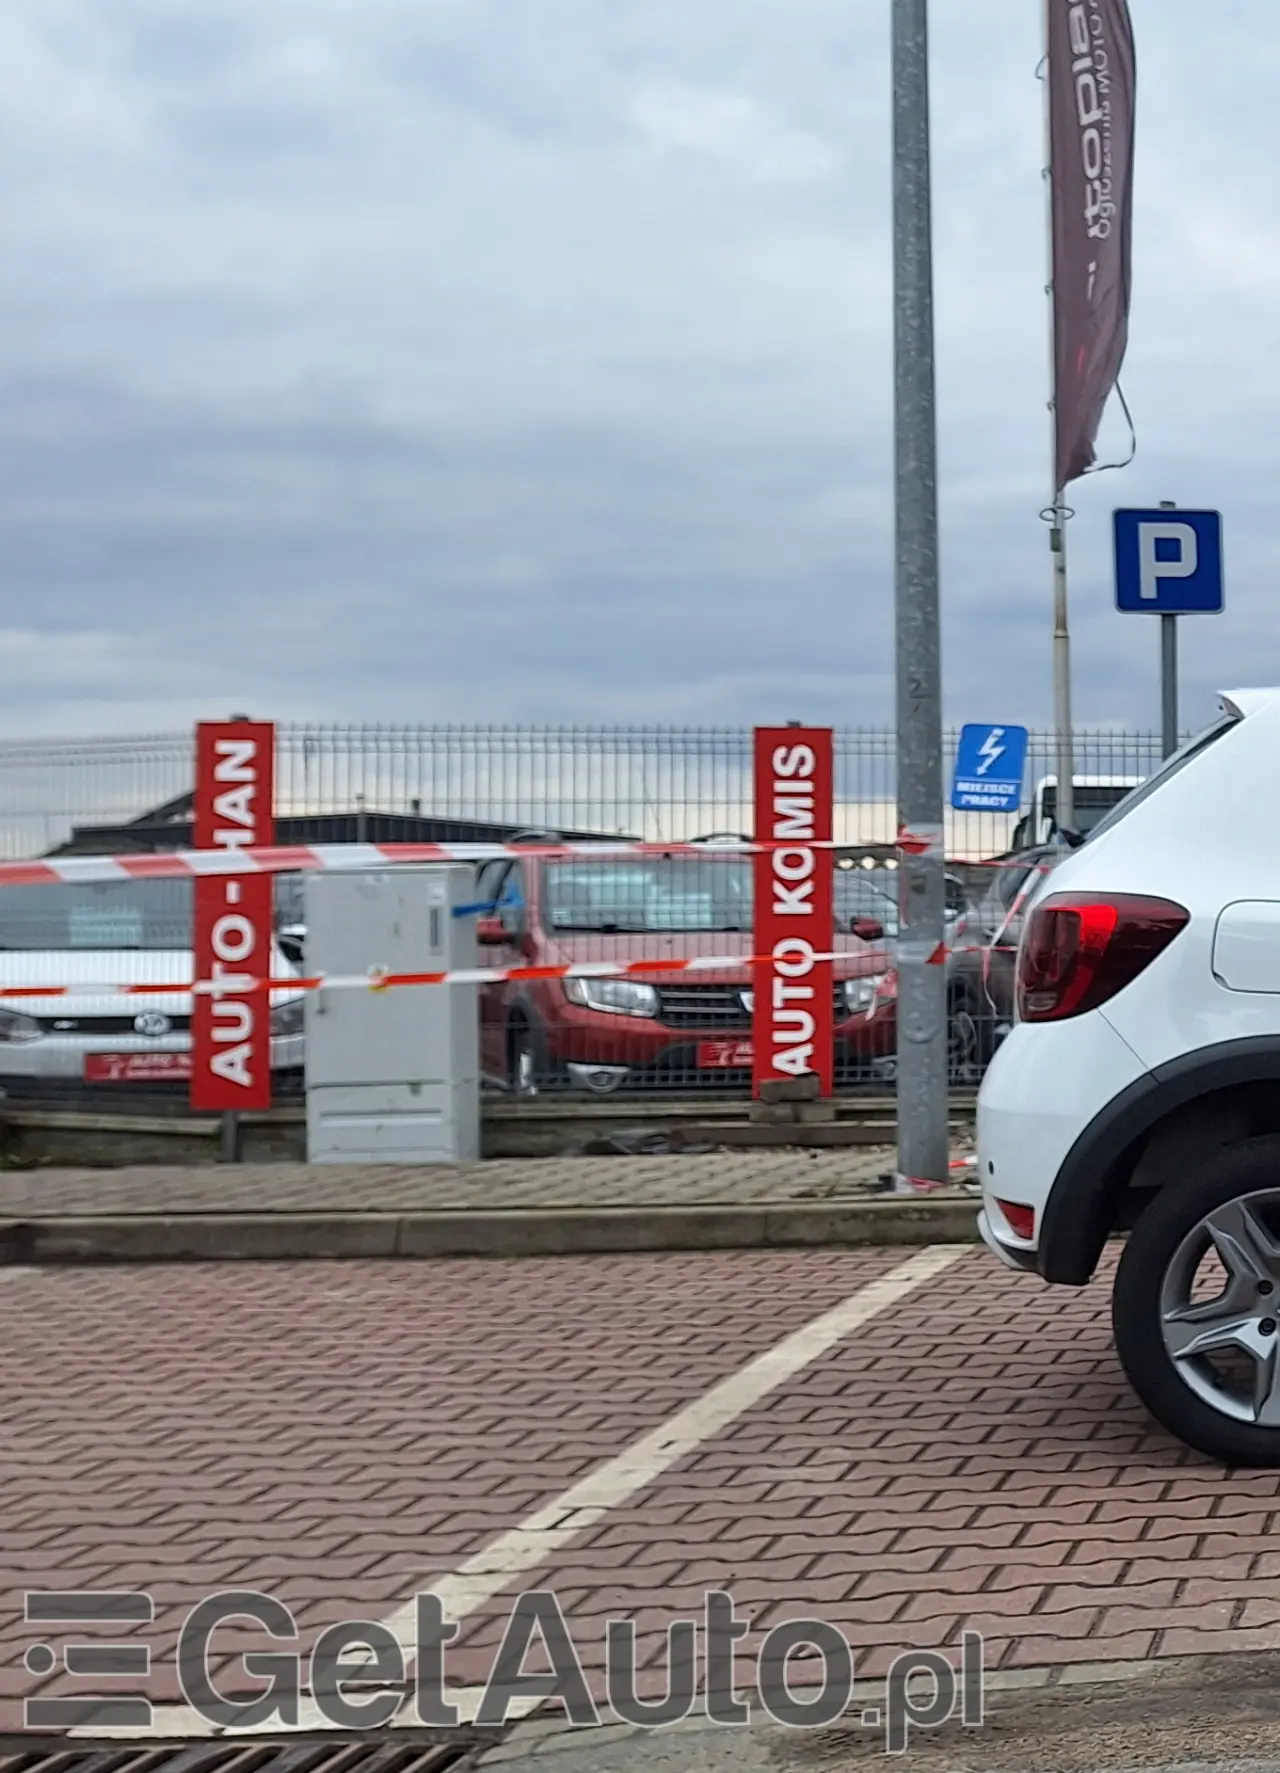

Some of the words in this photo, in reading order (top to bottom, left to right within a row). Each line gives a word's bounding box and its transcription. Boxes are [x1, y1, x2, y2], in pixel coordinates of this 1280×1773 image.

[1137, 522, 1198, 599] P
[772, 744, 817, 915] KOMIS
[772, 937, 817, 1076] AUTO
